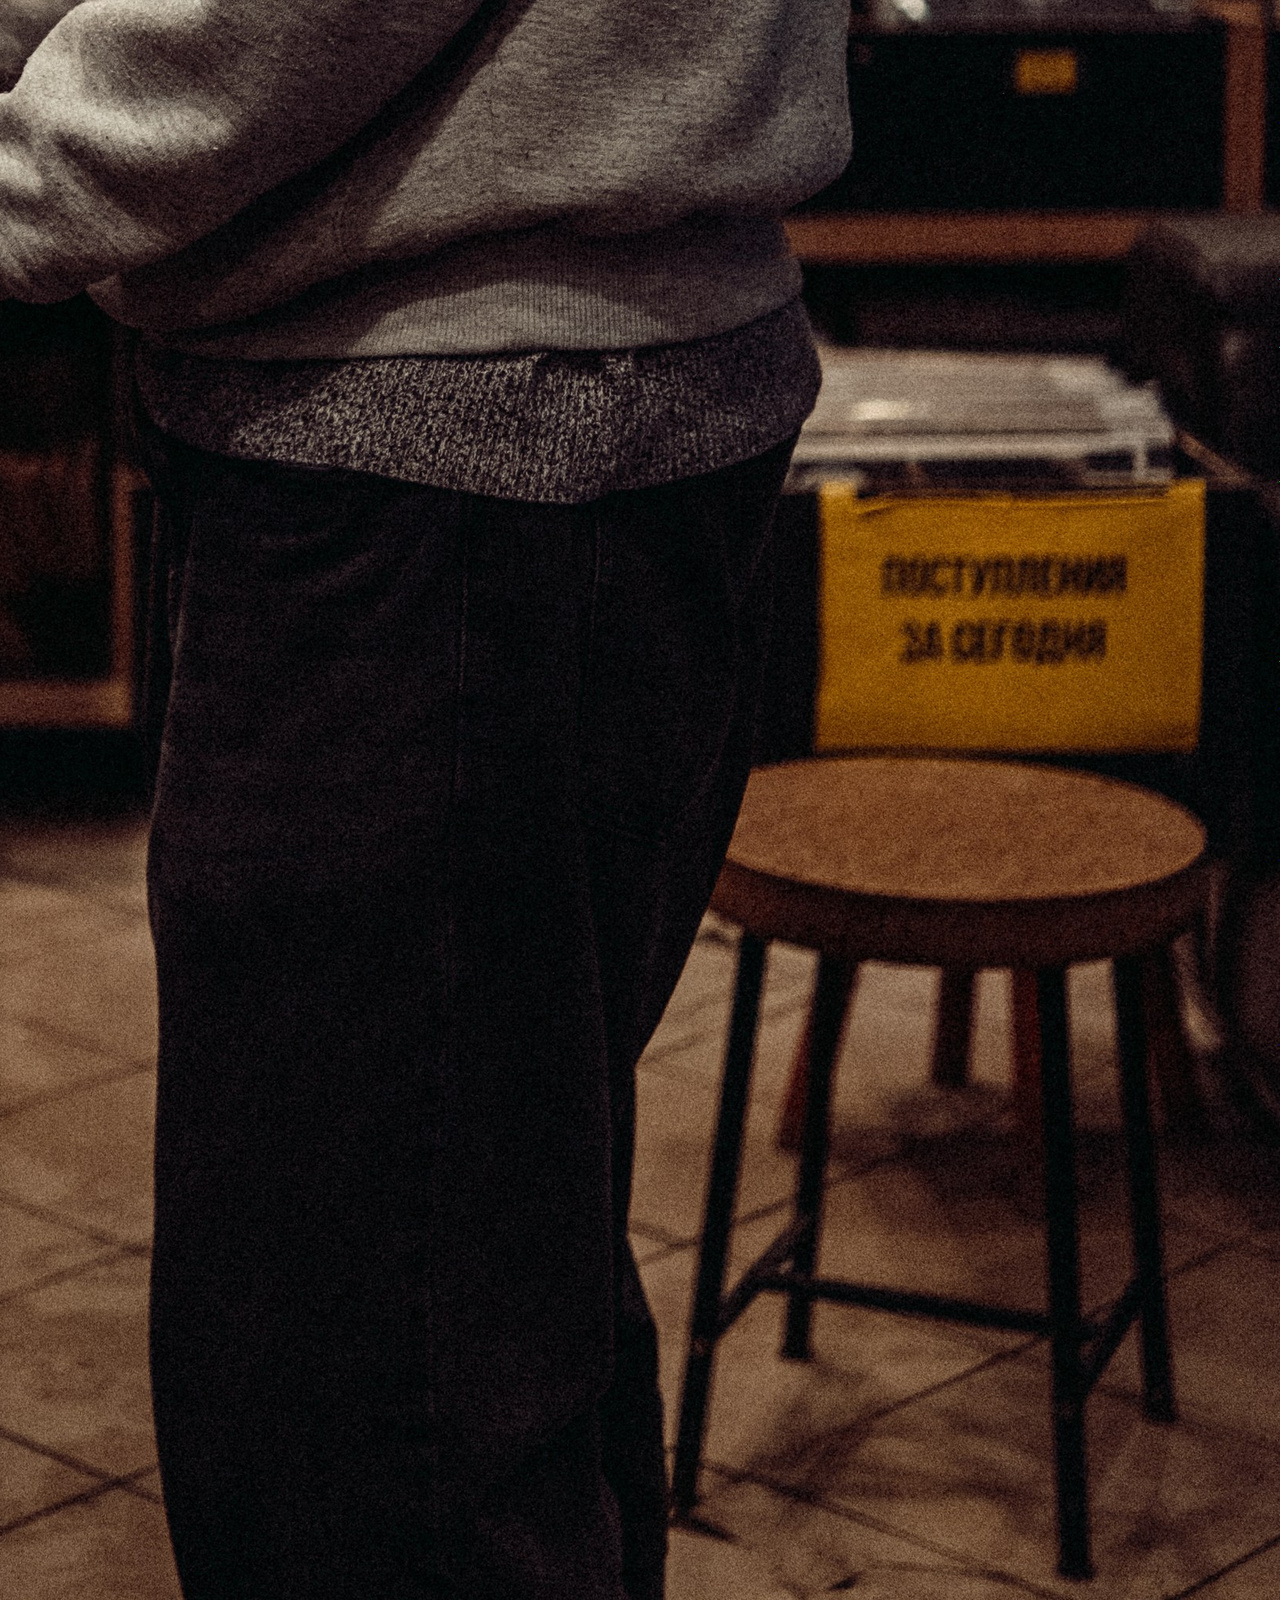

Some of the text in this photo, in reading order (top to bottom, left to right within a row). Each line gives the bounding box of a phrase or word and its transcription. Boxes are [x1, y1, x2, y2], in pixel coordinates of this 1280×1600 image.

[880, 555, 1127, 596] ПОСТУПЛЕНИЯ
[900, 618, 1108, 667] ЗА СЕГОДНЯ
